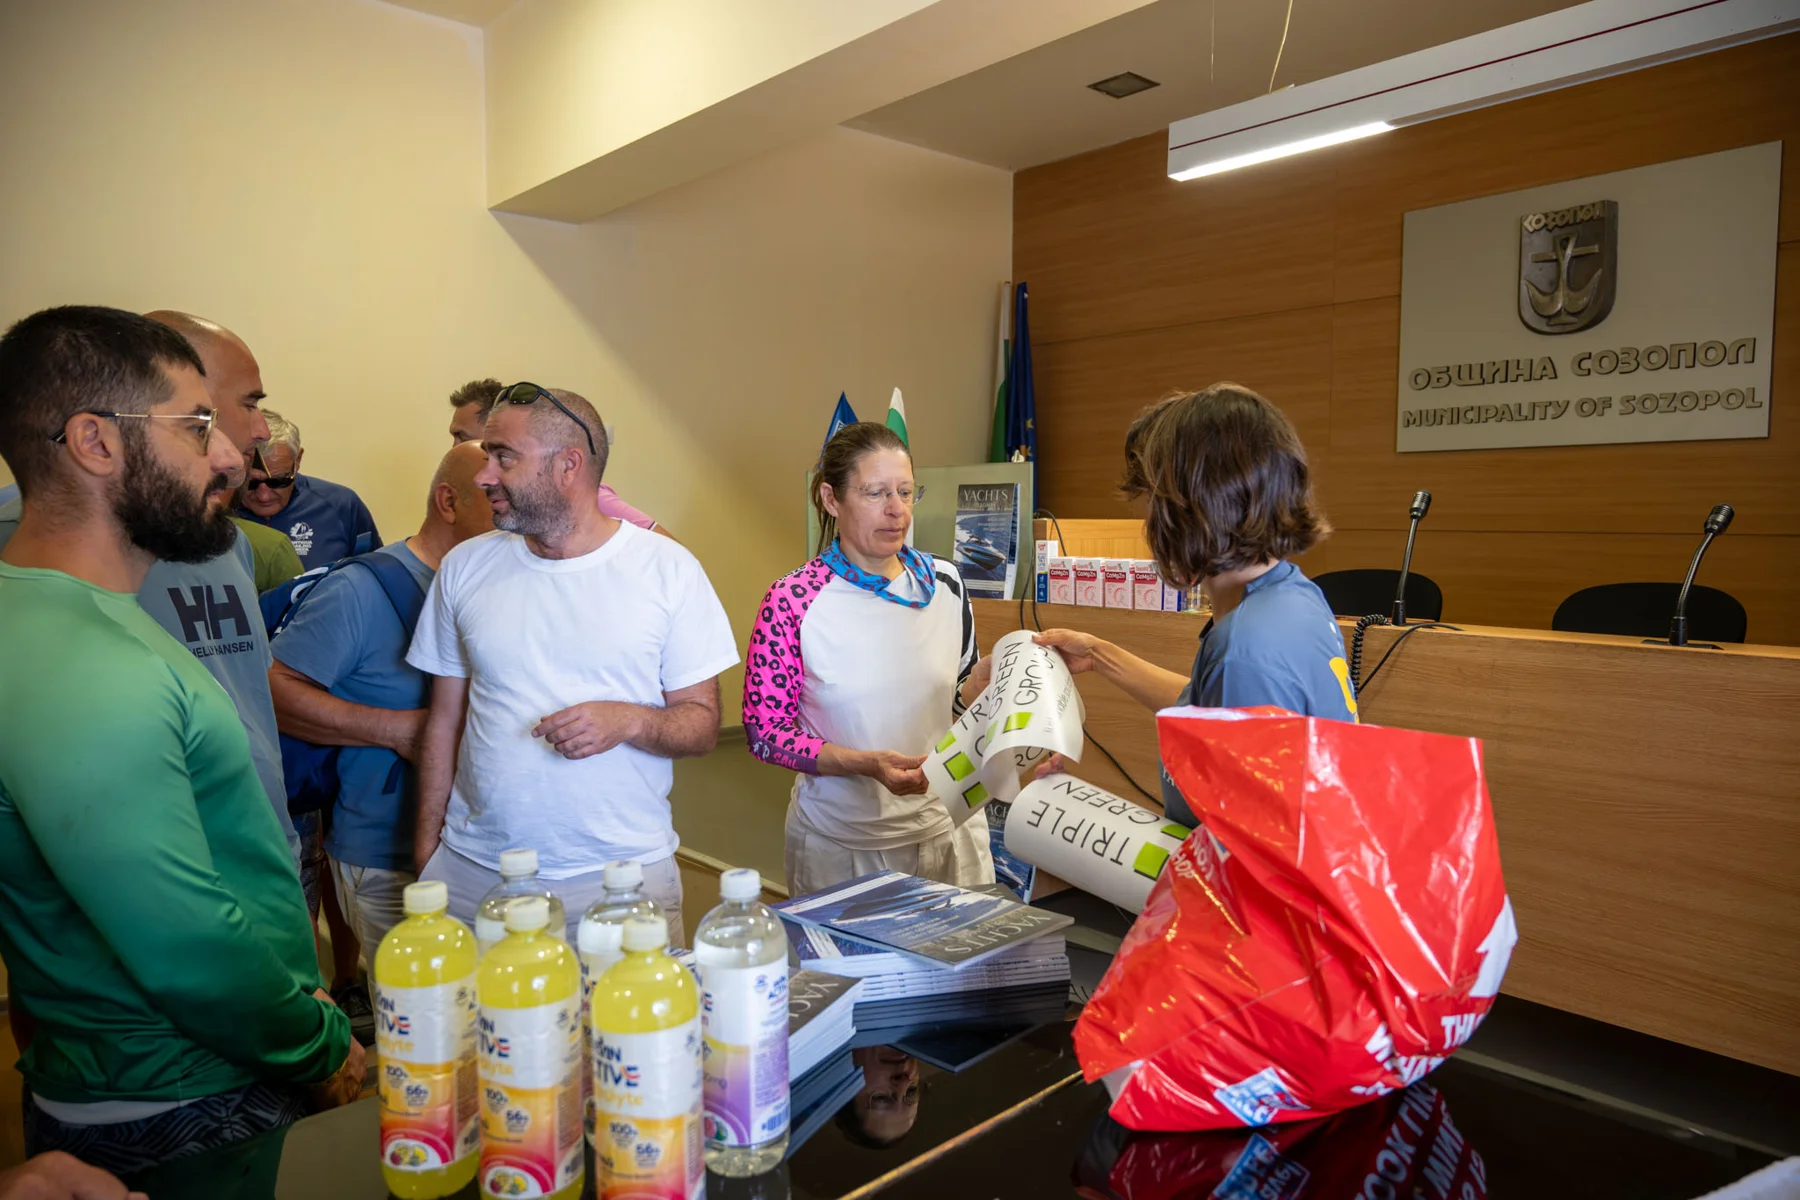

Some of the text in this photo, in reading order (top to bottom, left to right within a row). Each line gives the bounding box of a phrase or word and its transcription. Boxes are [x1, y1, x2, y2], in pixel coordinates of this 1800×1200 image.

[1408, 337, 1757, 391] ОБЩИНА СОЗОПОЛ
[1402, 387, 1763, 428] MUNICIPALITY OF SOZOPOL
[963, 489, 1009, 501] YACHTS
[167, 585, 252, 642] HH
[214, 641, 254, 656] HANSEN
[988, 641, 1024, 720] GREEN
[1053, 781, 1161, 824] GREEN
[1027, 800, 1130, 866] TRIPLE
[945, 914, 1051, 953] YACHTS
